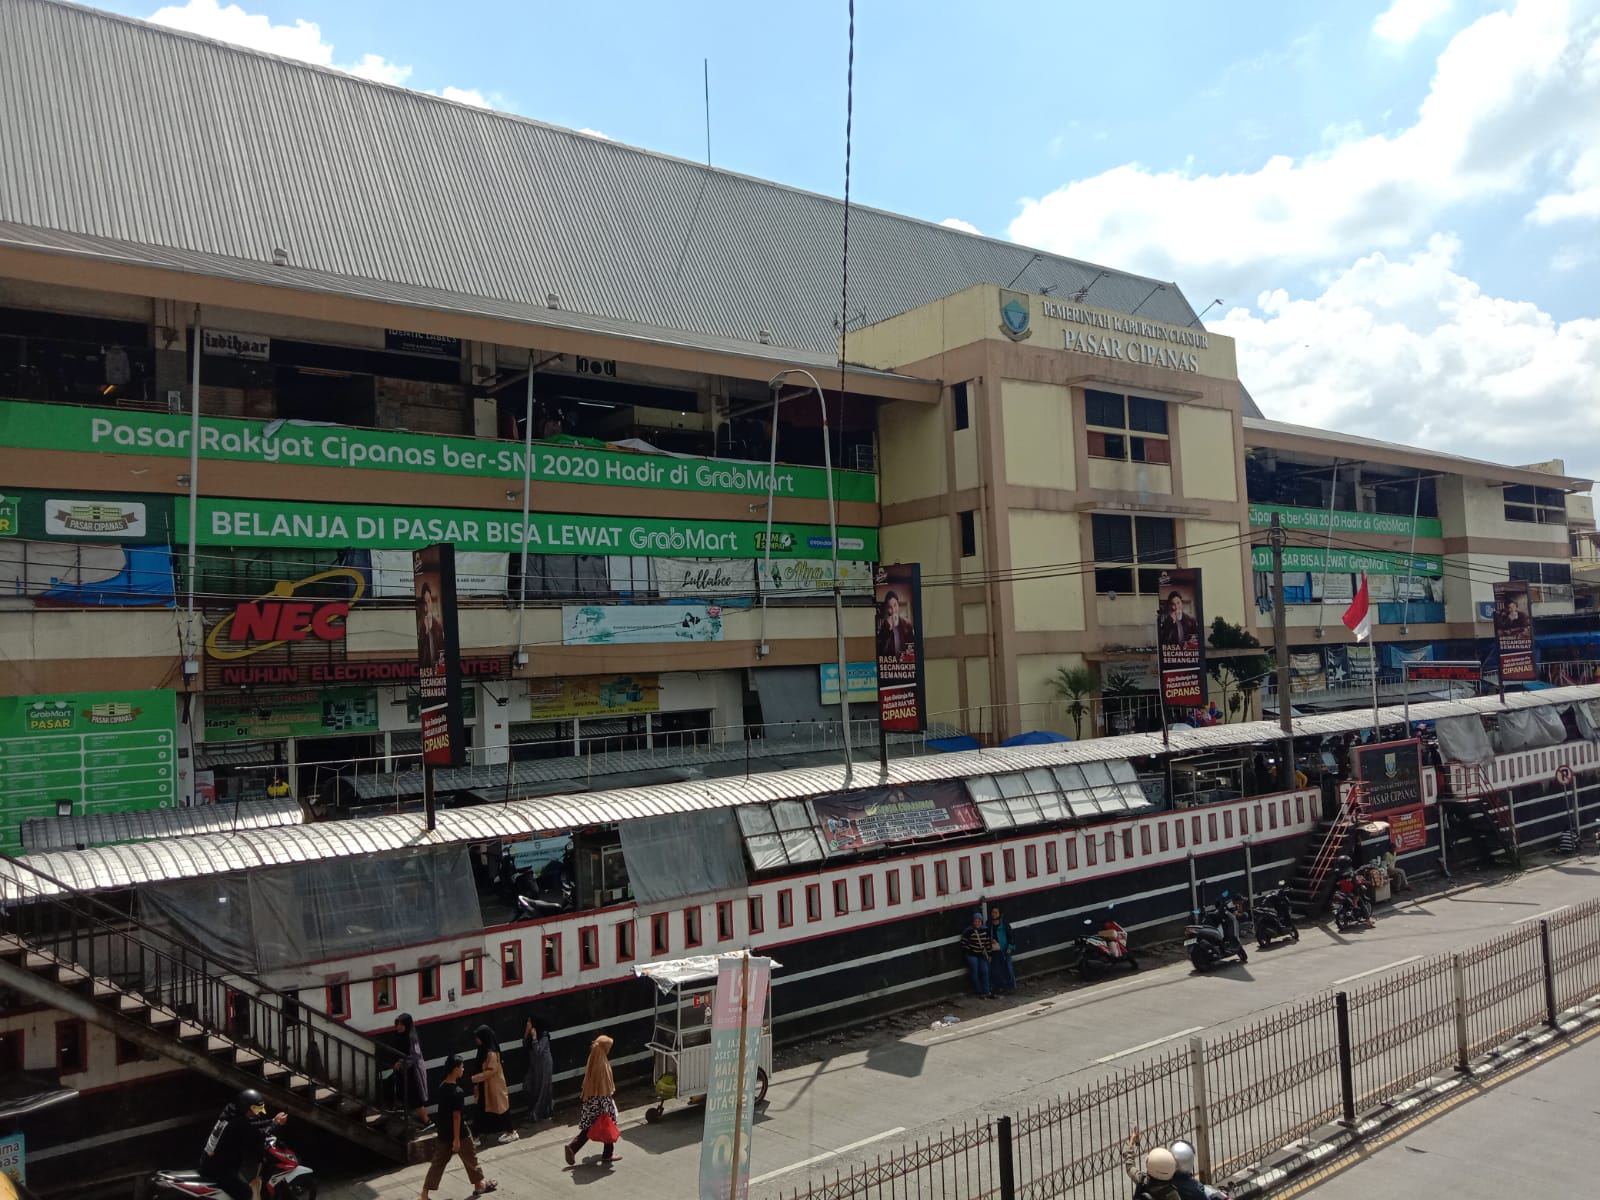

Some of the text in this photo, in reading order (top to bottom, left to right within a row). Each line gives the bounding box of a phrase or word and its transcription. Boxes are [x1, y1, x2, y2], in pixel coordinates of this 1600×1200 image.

[1043, 301, 1208, 351] PEMERINTAH KABUPATEN CIANJUR
[1063, 327, 1199, 374] PASAR CIPANAS
[92, 417, 796, 493] Pasar Rakyat Cipanas ber-SNI 2020 Hadir di GrabMart
[69, 519, 125, 532] PASAR CIPANAS
[1287, 512, 1319, 526] ber-SNI
[1341, 515, 1362, 530] Hadir
[1364, 517, 1371, 532] di
[212, 511, 739, 551] BELANJA DI PASAR BISA LEWAT GrabMart
[1259, 554, 1270, 566] DI
[1300, 555, 1320, 568] BISA
[1321, 556, 1347, 569] LEWAT
[229, 602, 349, 641] NEC
[879, 655, 898, 664] RASA
[1163, 650, 1200, 658] SECANGKIR
[879, 663, 917, 671] SECANGKIR
[1164, 657, 1200, 665] SEMANGAT
[224, 667, 298, 685] NUHUN
[879, 671, 917, 679] SEMANGAT
[1503, 664, 1534, 676] CIPANAS
[1165, 686, 1201, 699] CIPANAS
[30, 710, 72, 720] GrabMart
[882, 706, 918, 721] CIPANAS
[31, 719, 71, 730] PASAR
[205, 718, 236, 729] Harga
[237, 727, 248, 736] DI
[424, 733, 450, 753] CIPANAS
[1368, 791, 1390, 806] PASAR
